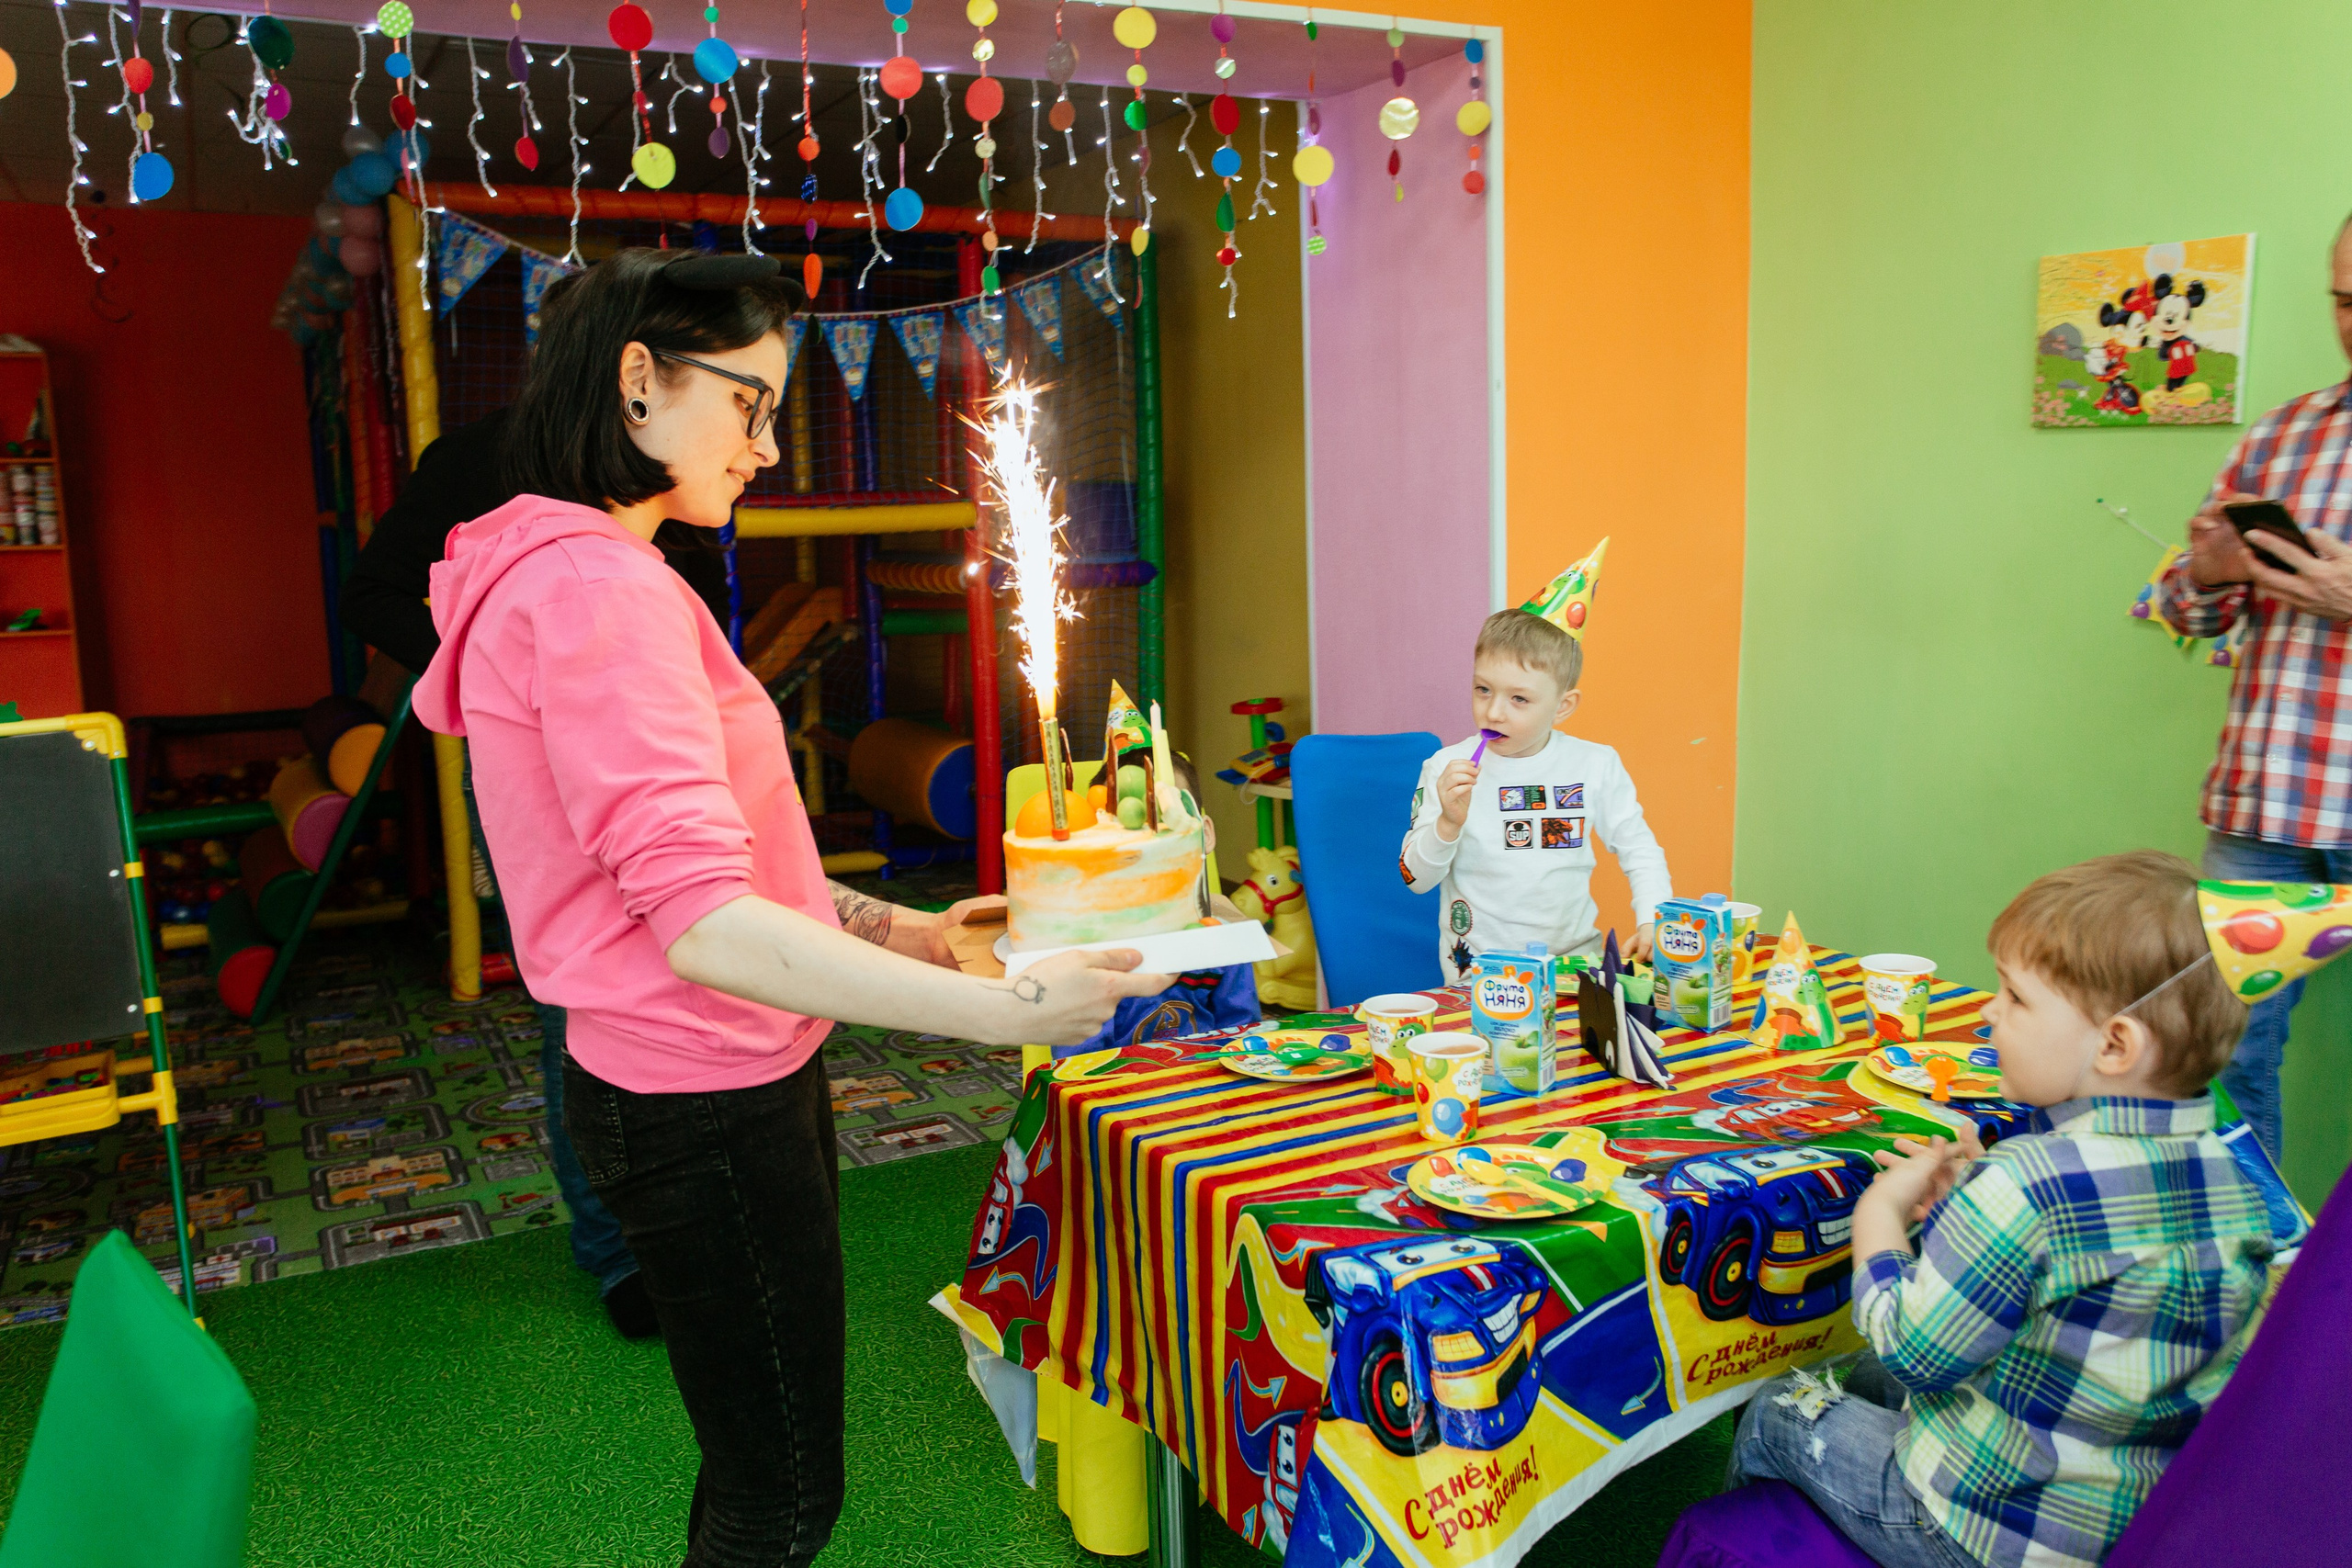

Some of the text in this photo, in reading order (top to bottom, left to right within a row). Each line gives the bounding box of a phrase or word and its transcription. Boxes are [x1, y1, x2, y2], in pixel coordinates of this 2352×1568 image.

[1508, 829, 1530, 841] SUP
[1484, 979, 1525, 995] Фруто
[1687, 1353, 1709, 1382] С
[1703, 1325, 1834, 1386] рождения!
[1404, 1457, 1502, 1540] С днём
[1435, 1444, 1539, 1550] рождения!
